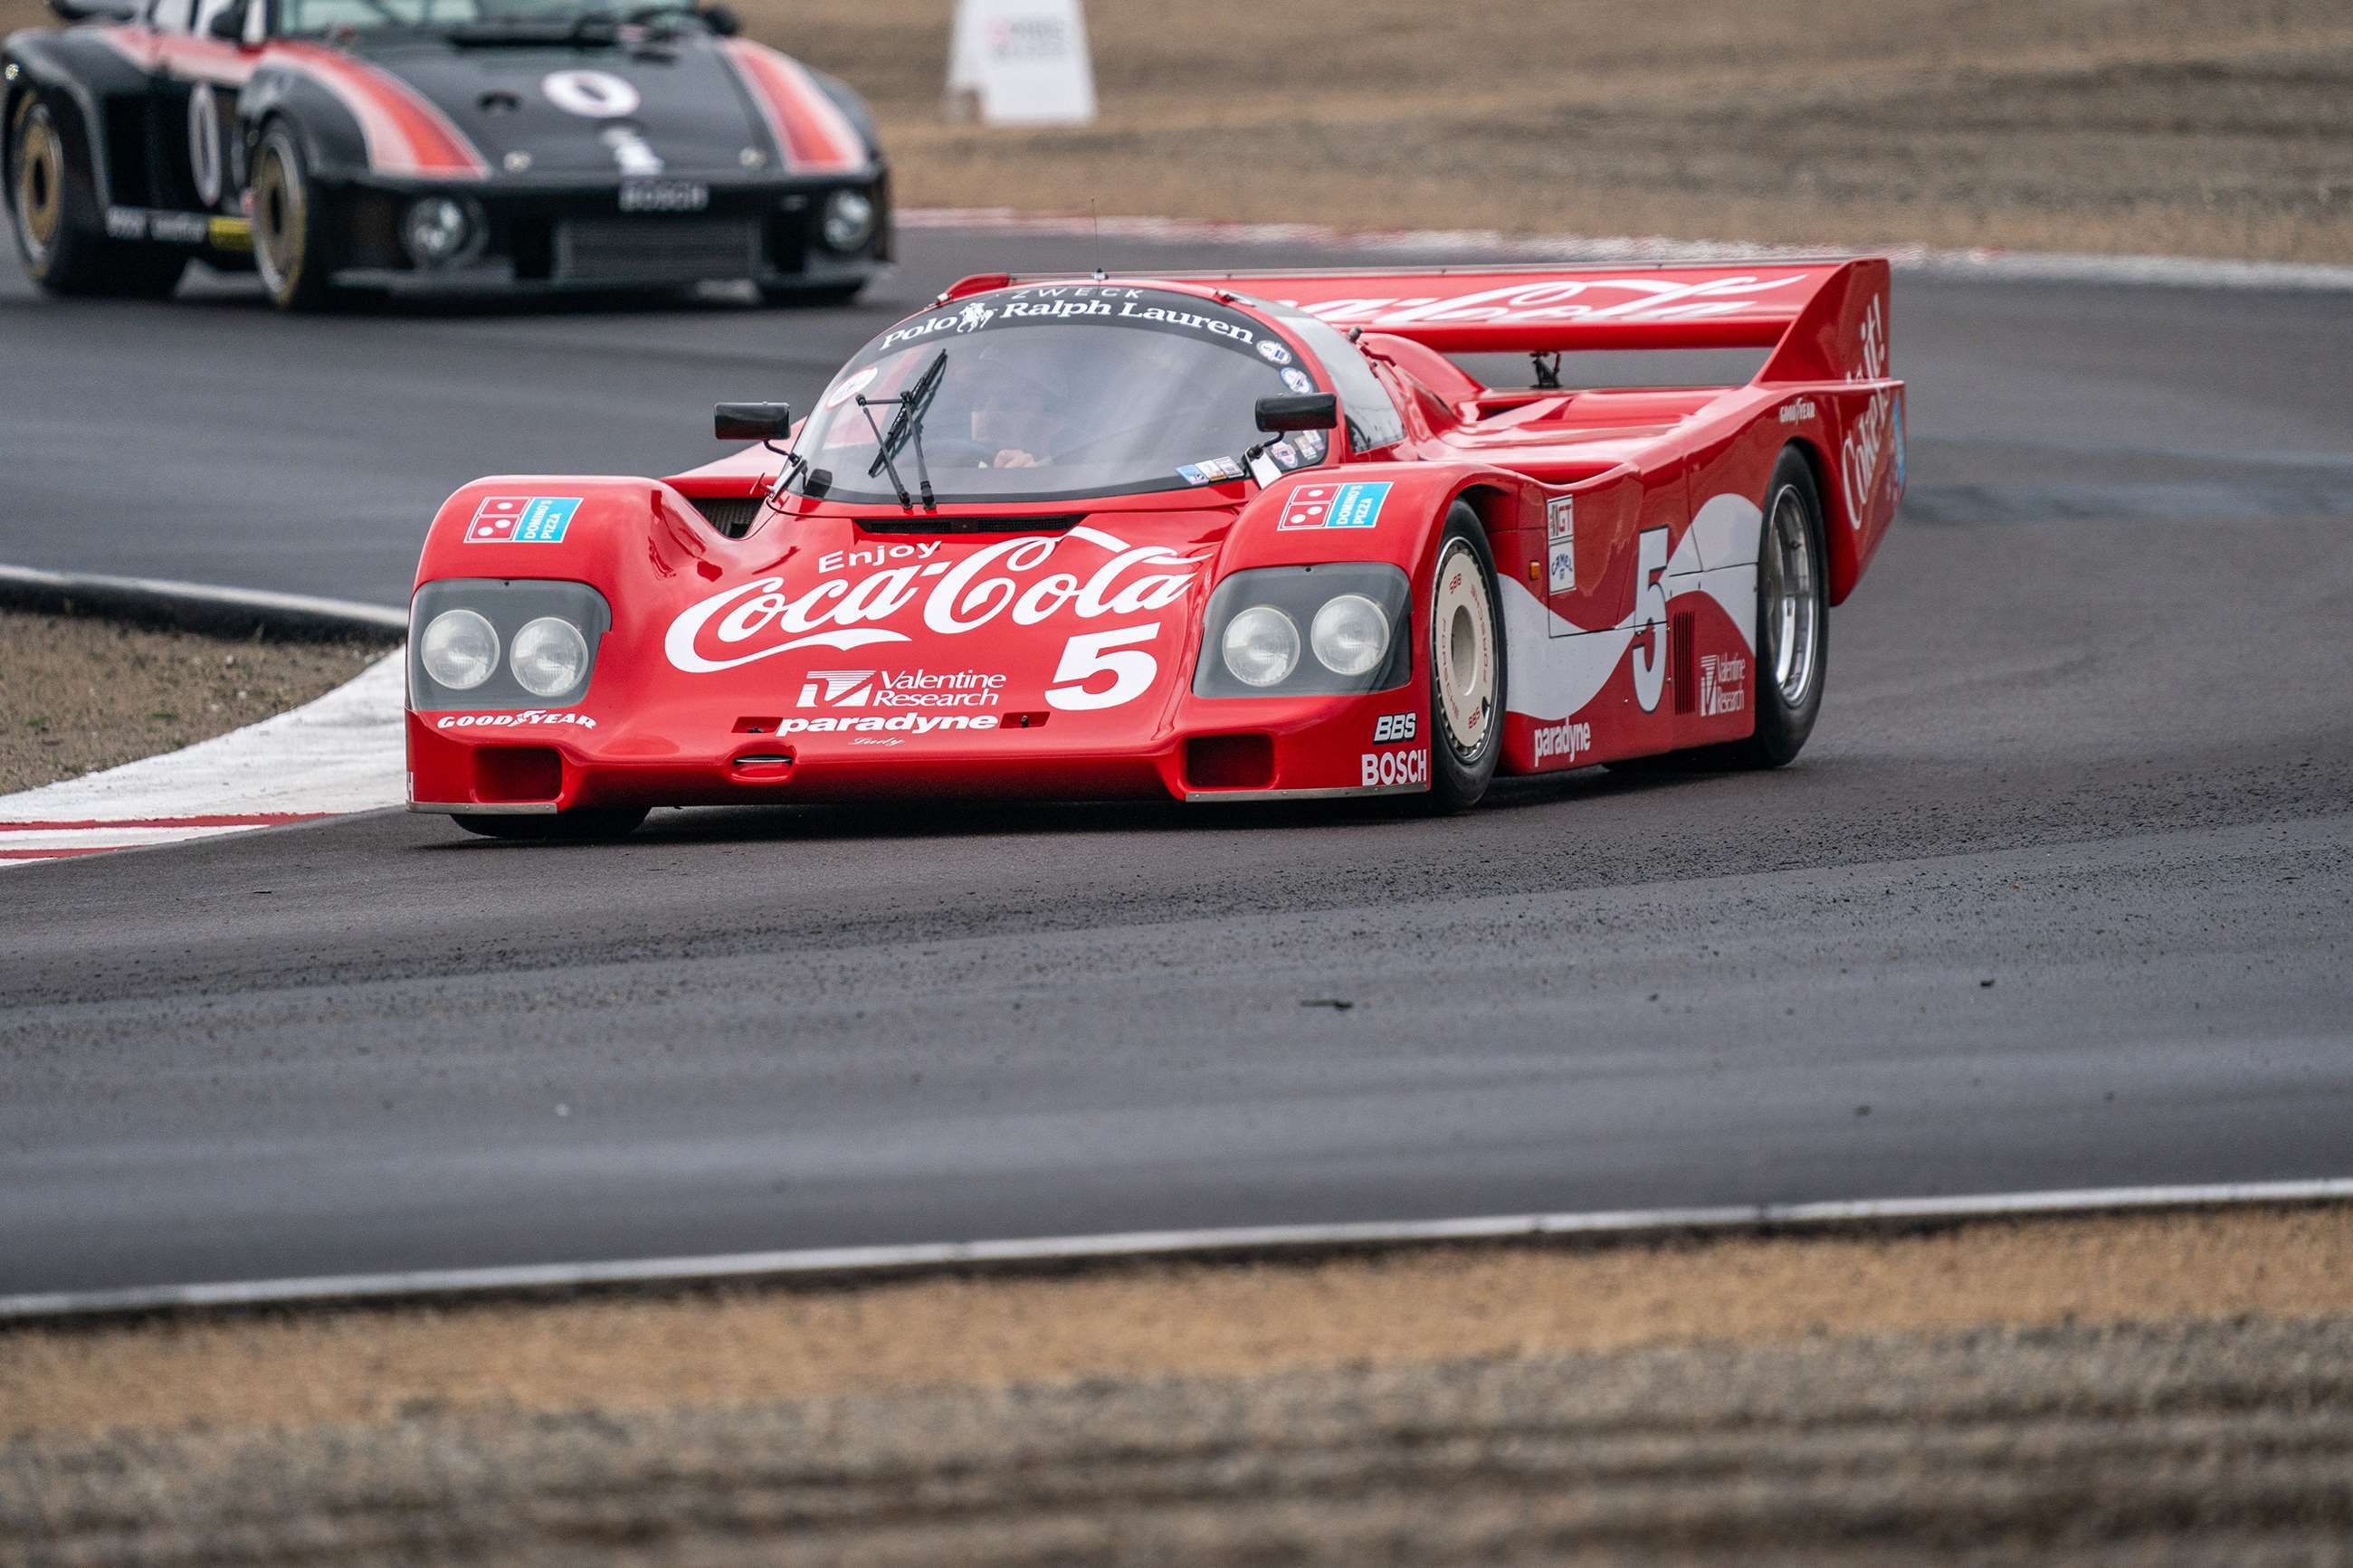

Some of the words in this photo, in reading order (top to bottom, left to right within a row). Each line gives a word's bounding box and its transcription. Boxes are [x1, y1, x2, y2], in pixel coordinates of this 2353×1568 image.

[880, 316, 957, 351] Polo
[999, 299, 1111, 318] Ralph
[1119, 301, 1254, 345] Lauren
[540, 512, 563, 539] PIZZA
[1352, 498, 1374, 525] PIZZA
[818, 540, 941, 573] Enjoy
[664, 527, 1213, 673] Coca-Cola
[1633, 525, 1671, 714] 5
[881, 669, 1006, 689] Valentine
[1044, 622, 1161, 710] 5
[872, 688, 999, 708] Research
[438, 710, 596, 729] GOODYEAR
[776, 712, 999, 737] paradyne
[1373, 711, 1417, 745] BBS
[1534, 716, 1591, 768] paradyne
[1361, 749, 1427, 786] BOSCH
